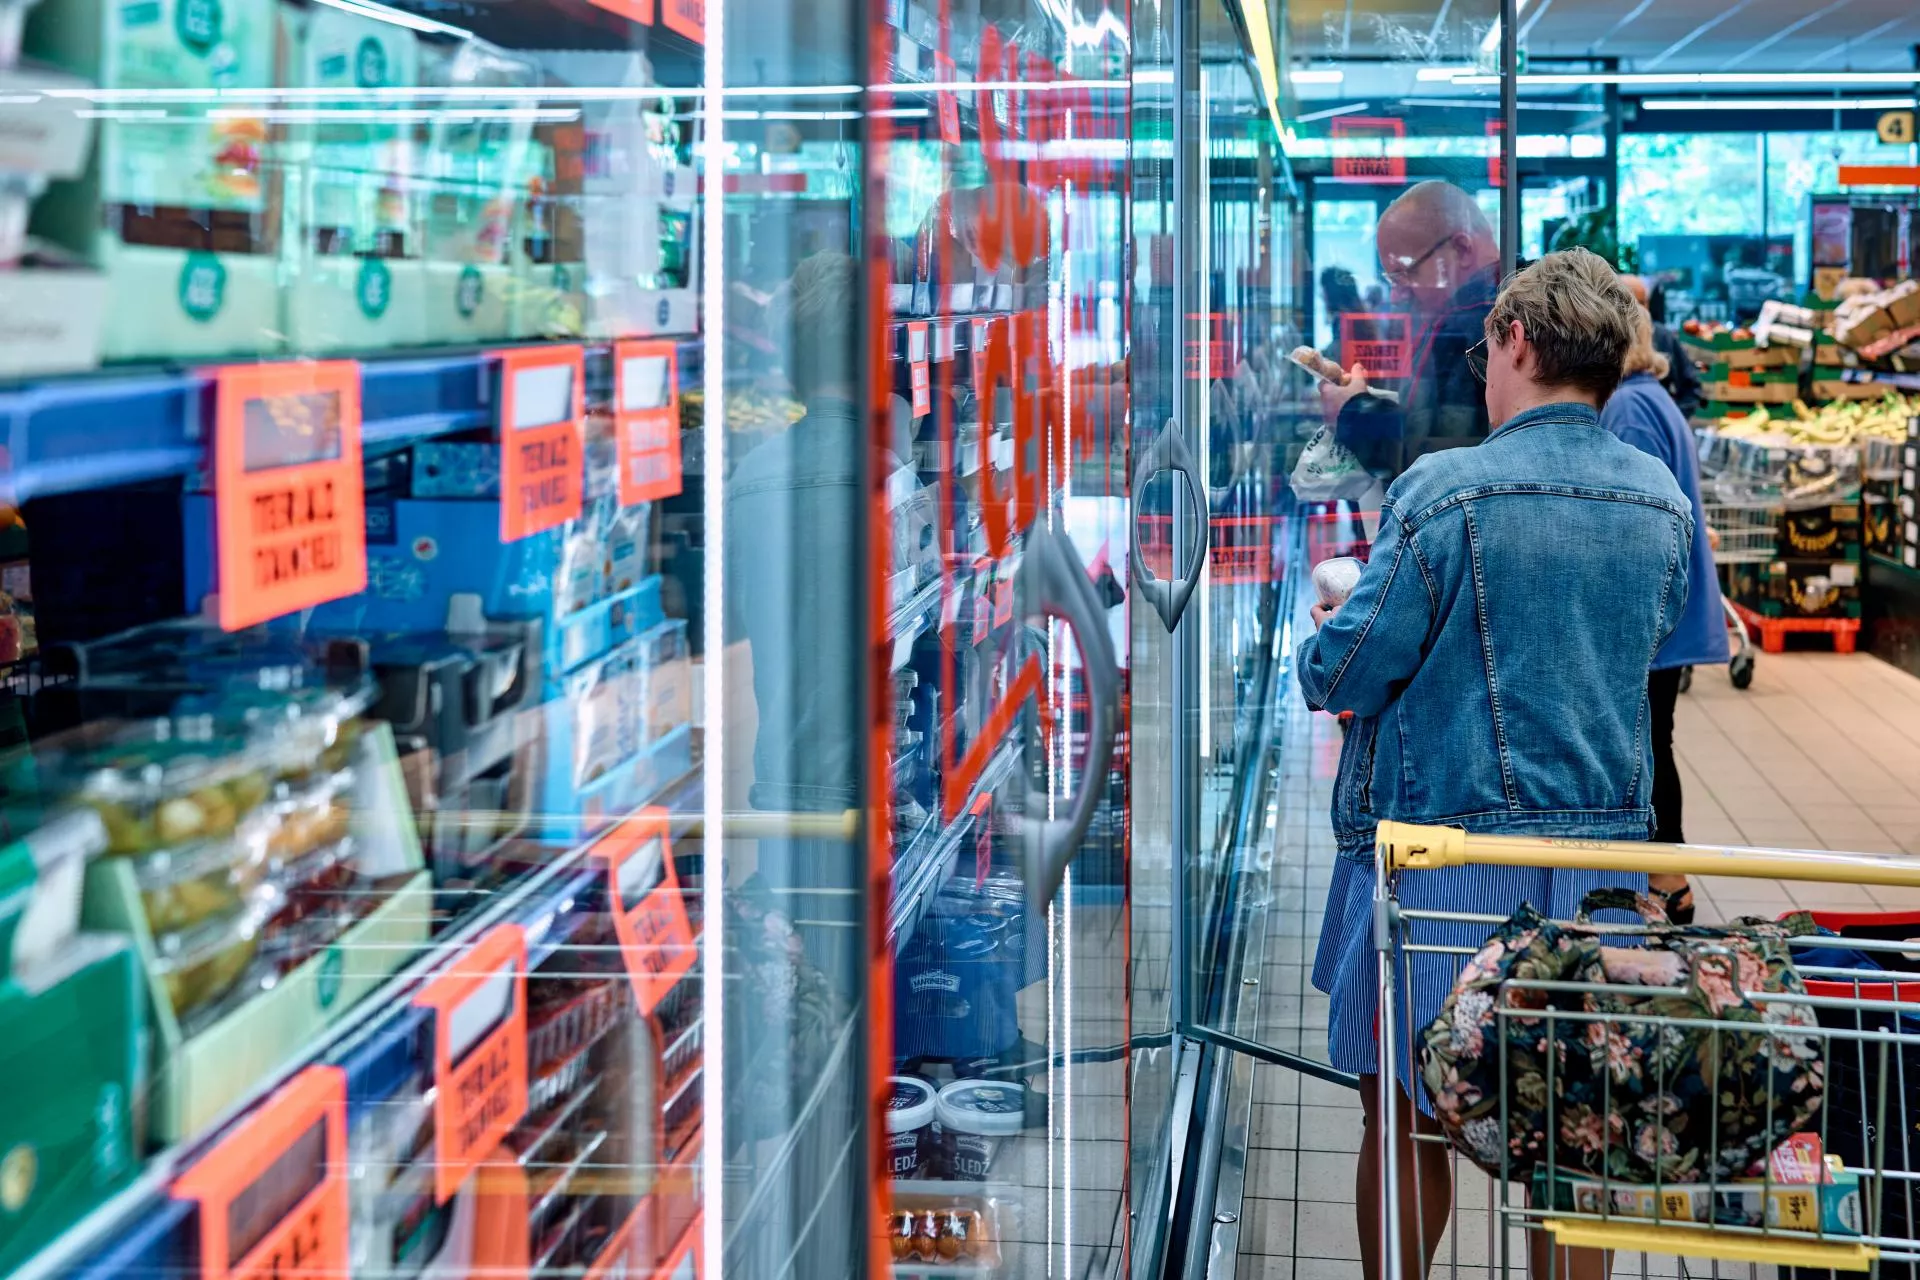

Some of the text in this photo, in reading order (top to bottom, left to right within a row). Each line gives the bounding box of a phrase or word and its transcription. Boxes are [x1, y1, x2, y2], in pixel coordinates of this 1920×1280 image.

[1888, 117, 1903, 138] 4
[887, 1149, 918, 1173] LEDŹ
[954, 1152, 991, 1176] ŚLEDŹ
